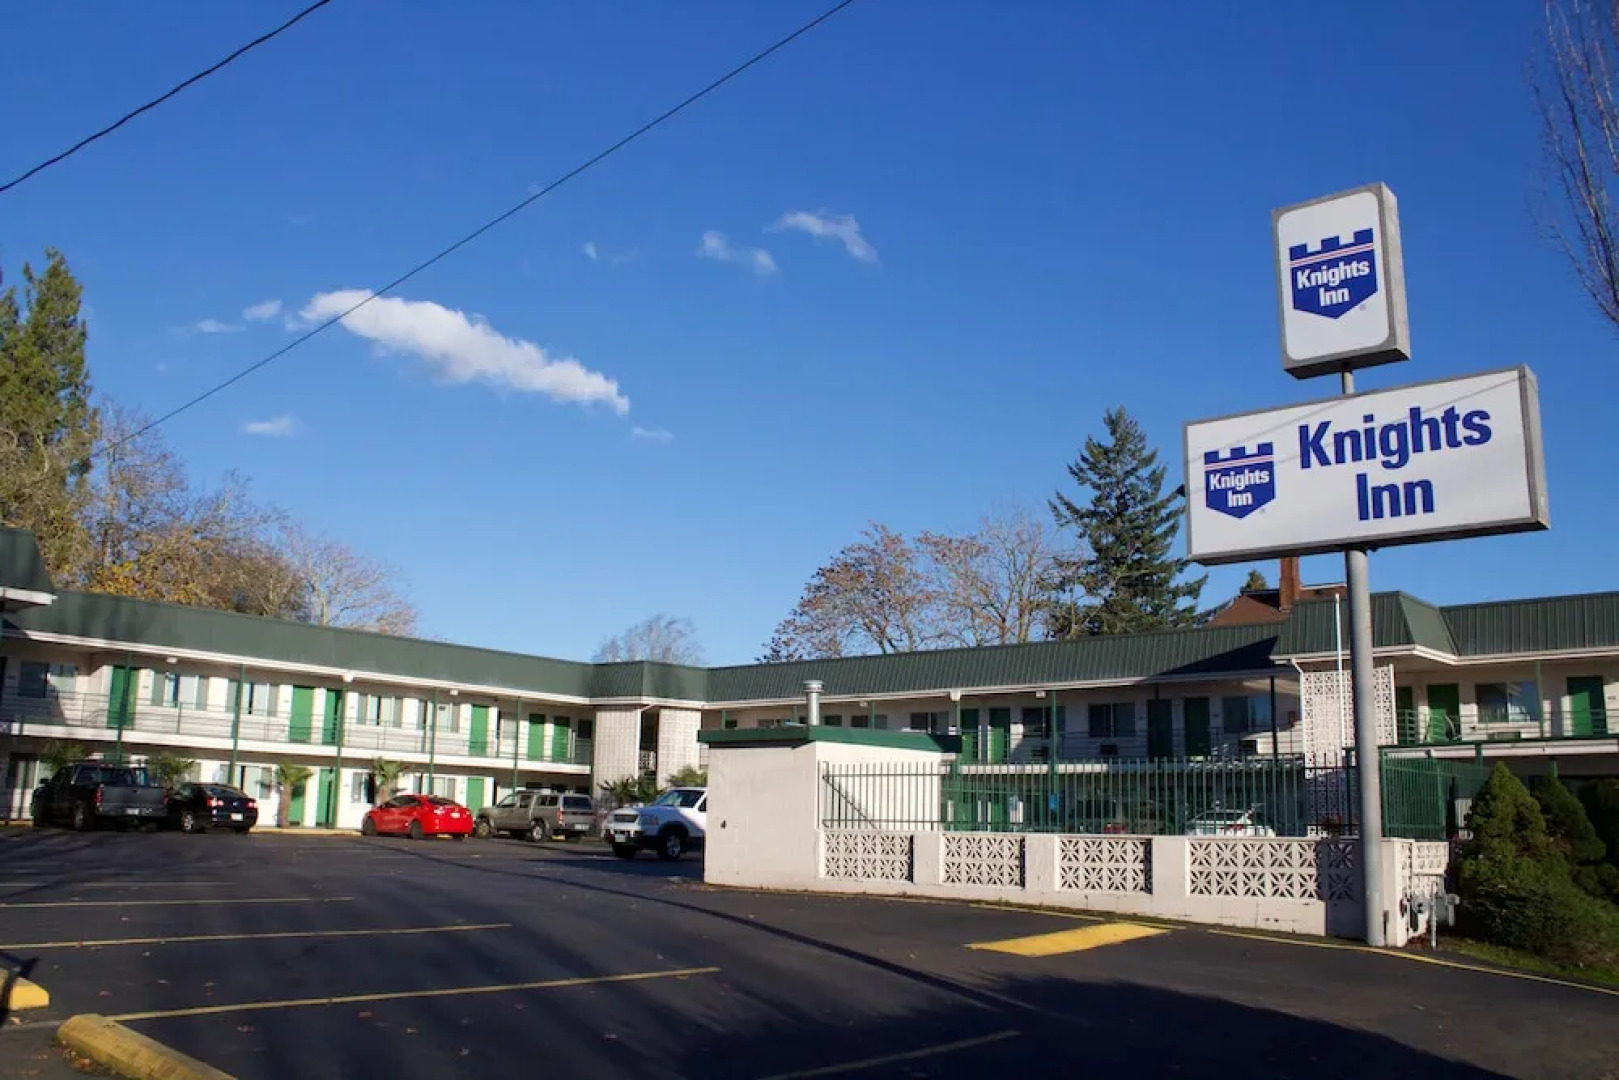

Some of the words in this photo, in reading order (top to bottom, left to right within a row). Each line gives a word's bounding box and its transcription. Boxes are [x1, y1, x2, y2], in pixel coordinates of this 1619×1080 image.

[1297, 261, 1370, 290] Knights
[1319, 287, 1350, 307] Inn
[1298, 406, 1492, 469] Knights
[1210, 468, 1270, 490] Knights
[1228, 490, 1253, 508] Inn
[1356, 473, 1434, 521] Inn
